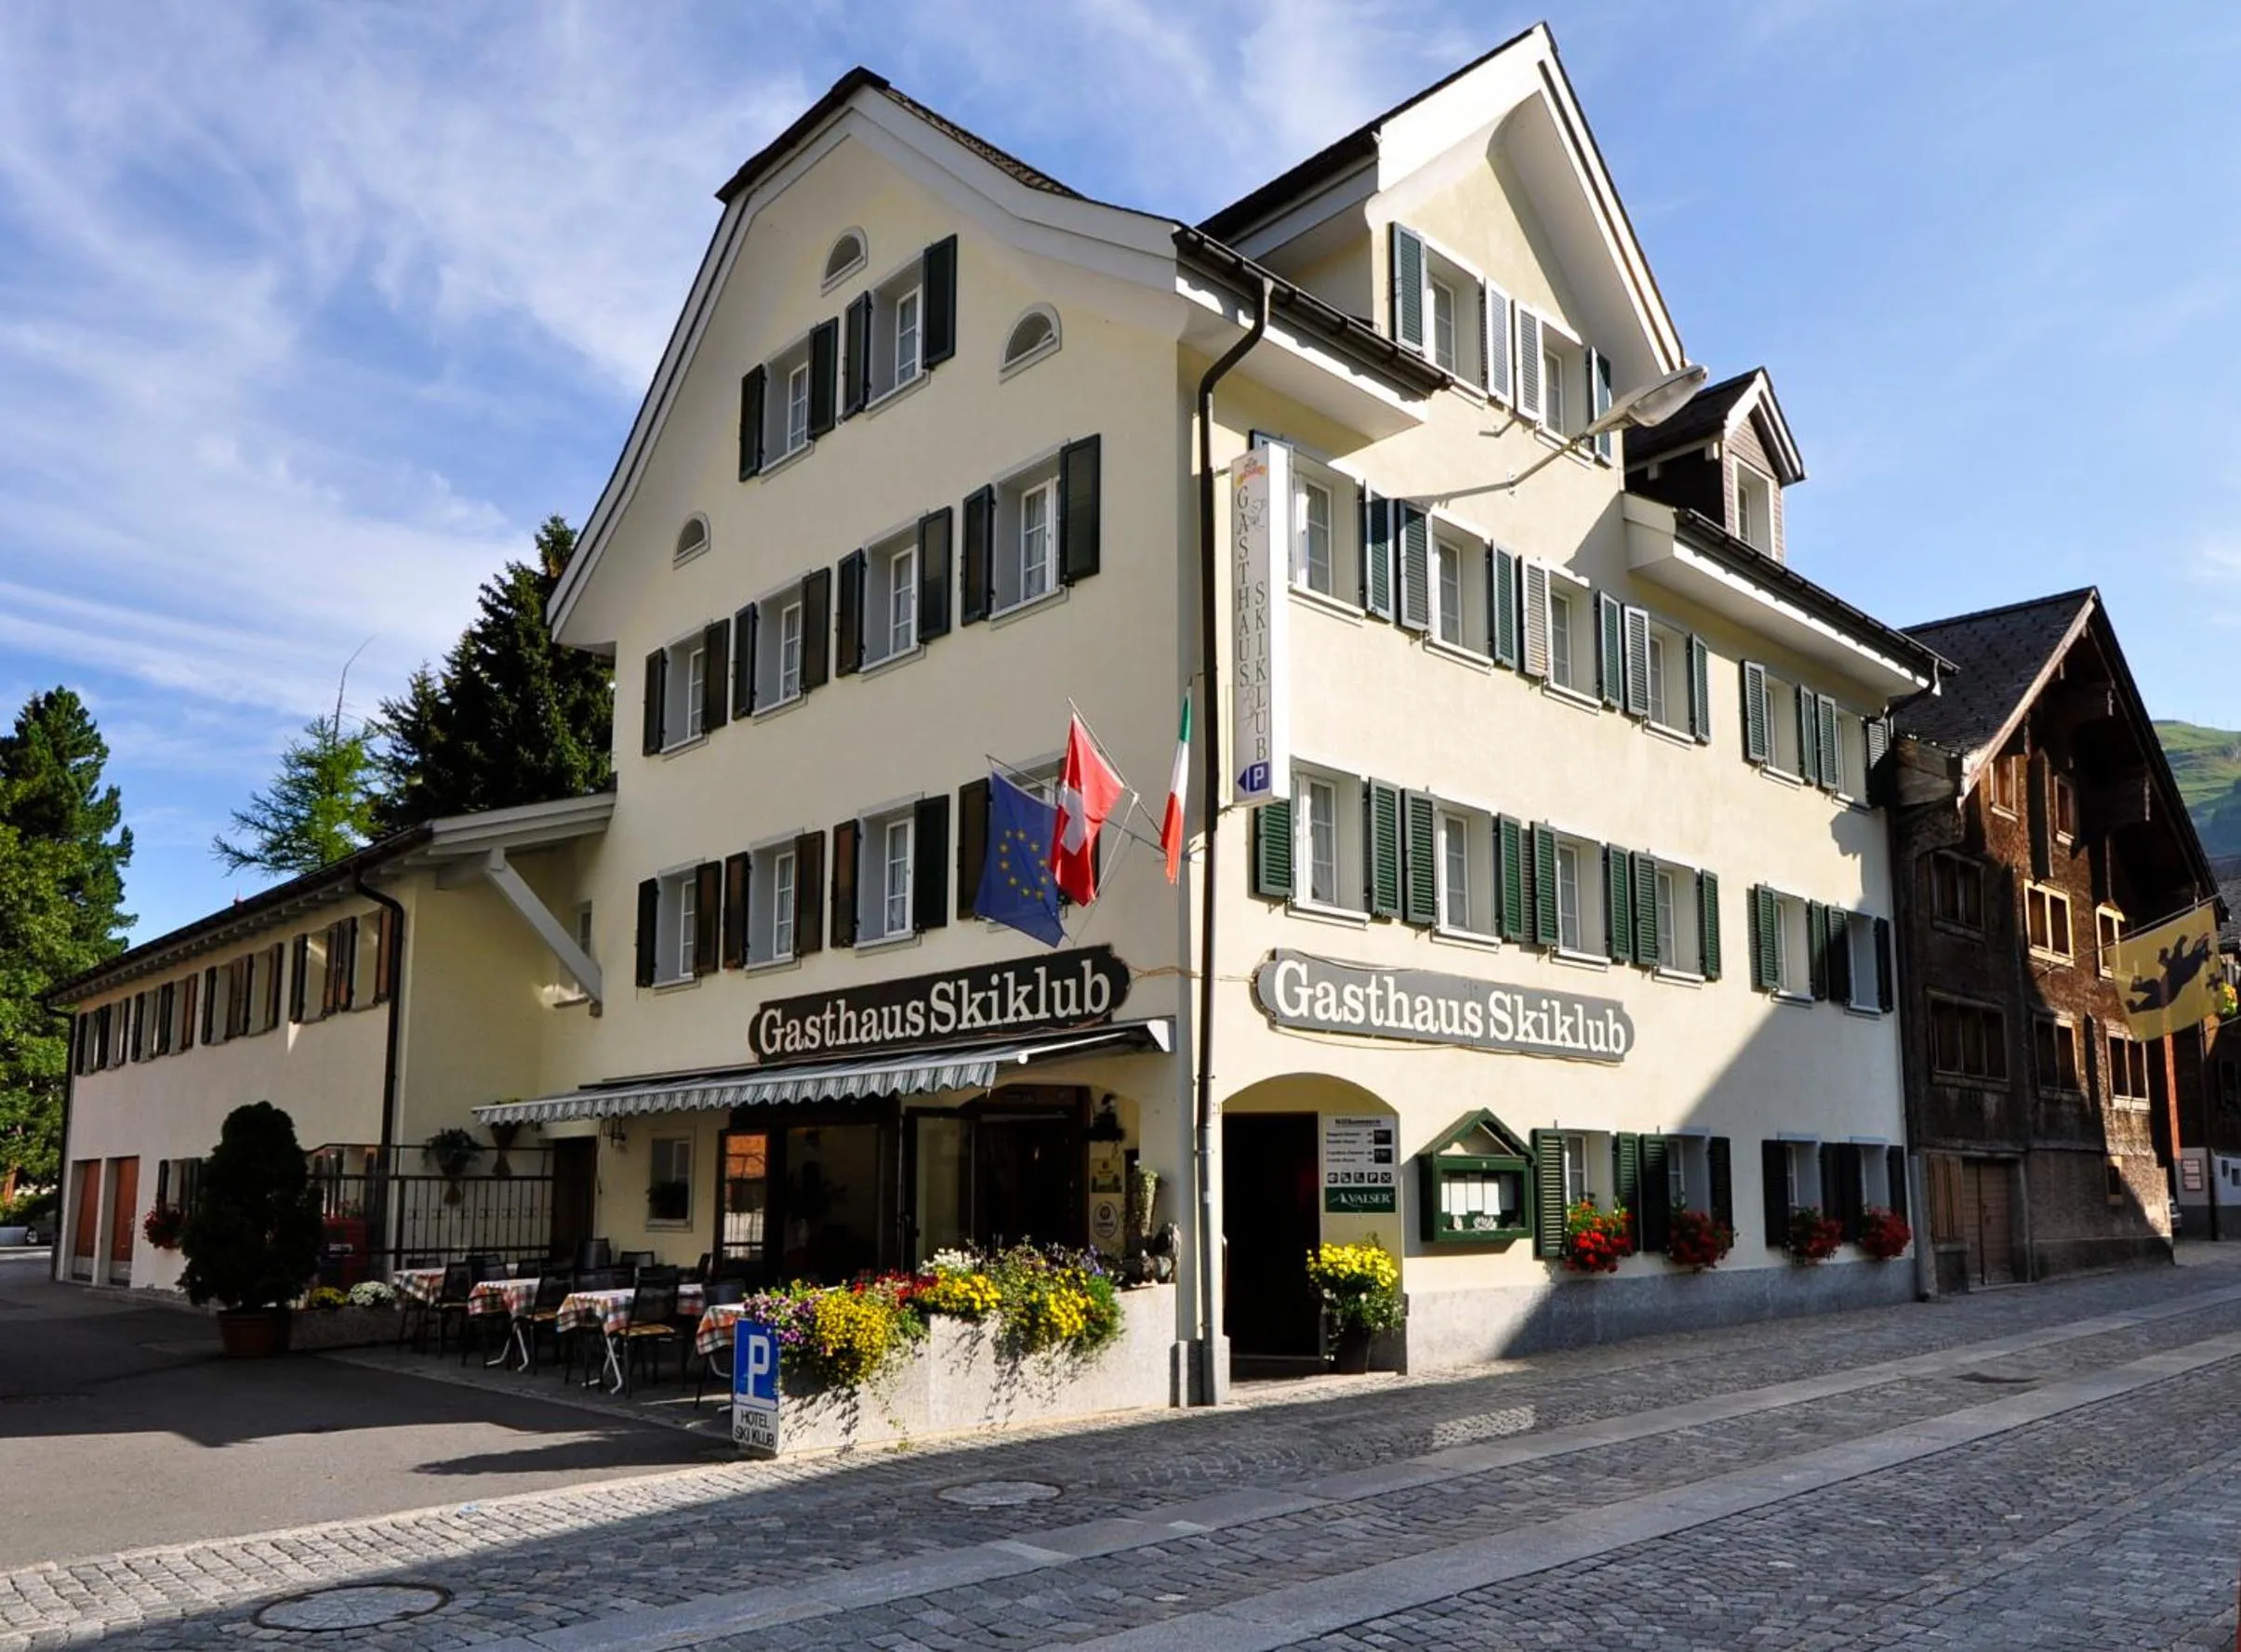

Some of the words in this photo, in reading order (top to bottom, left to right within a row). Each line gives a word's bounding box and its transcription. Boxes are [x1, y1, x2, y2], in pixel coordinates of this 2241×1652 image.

[1237, 485, 1250, 688] GASTHAUS
[1255, 581, 1266, 760] SKIKLUB
[1253, 767, 1265, 789] P
[760, 998, 926, 1055] Gasthaus
[930, 959, 1111, 1034] Skiklub
[1274, 959, 1483, 1038] Gasthaus
[1488, 990, 1626, 1056] Skiklub
[1348, 1193, 1391, 1205] VALSER
[748, 1335, 770, 1398] P
[741, 1409, 770, 1429] HOTEL
